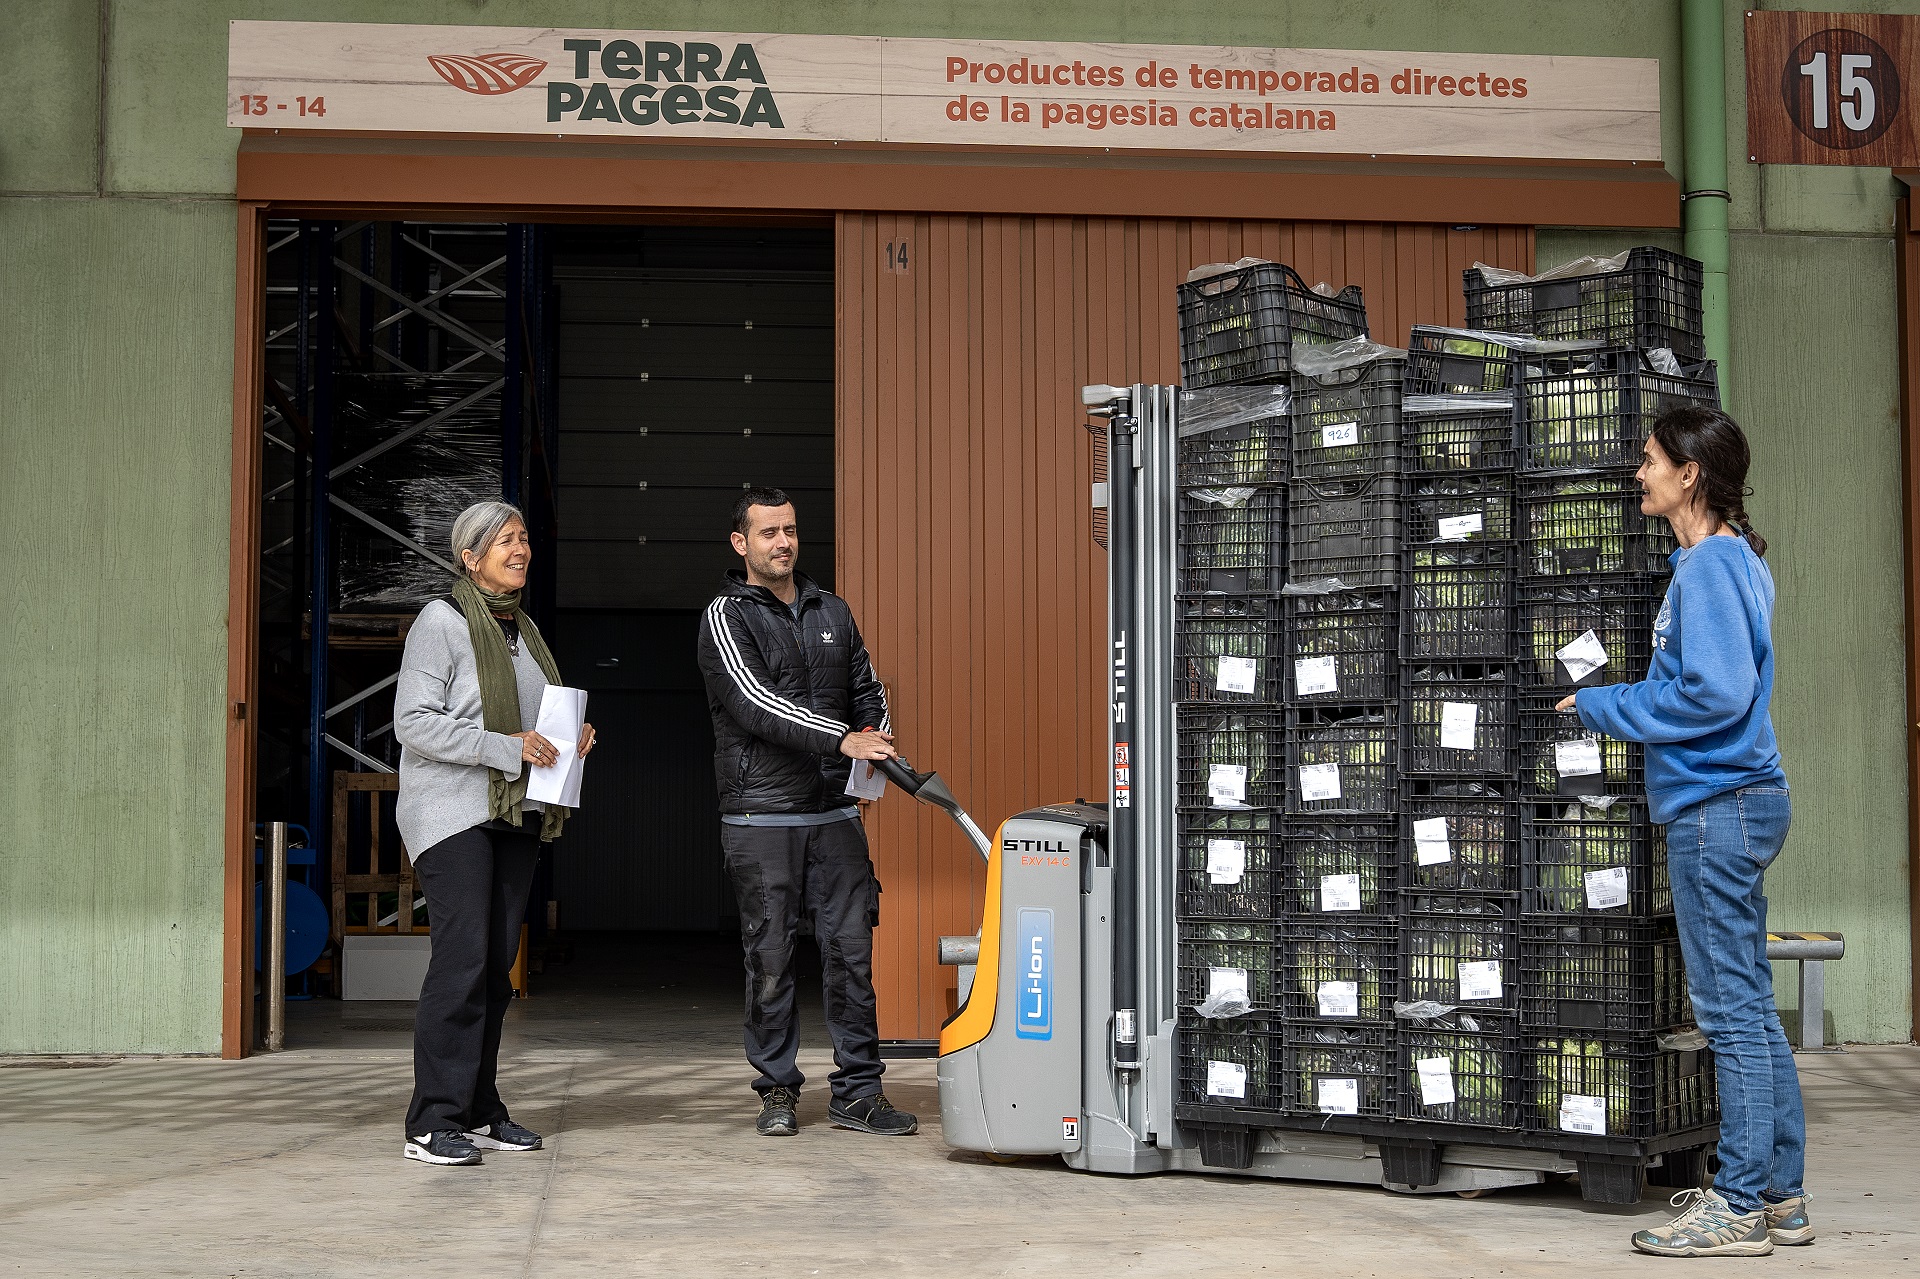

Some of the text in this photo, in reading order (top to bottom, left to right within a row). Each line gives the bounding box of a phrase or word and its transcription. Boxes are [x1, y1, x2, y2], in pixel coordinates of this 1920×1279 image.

[947, 57, 1528, 98] Productes de temporada directes
[1801, 53, 1876, 131] 15
[240, 96, 268, 116] 13
[297, 97, 326, 117] 14
[946, 94, 1337, 131] de la pagesia catalana
[886, 242, 908, 270] 14
[1328, 428, 1351, 441] 926
[1113, 631, 1126, 723] STILL
[1004, 840, 1070, 853] STILL
[1021, 856, 1071, 867] EXV 14 C
